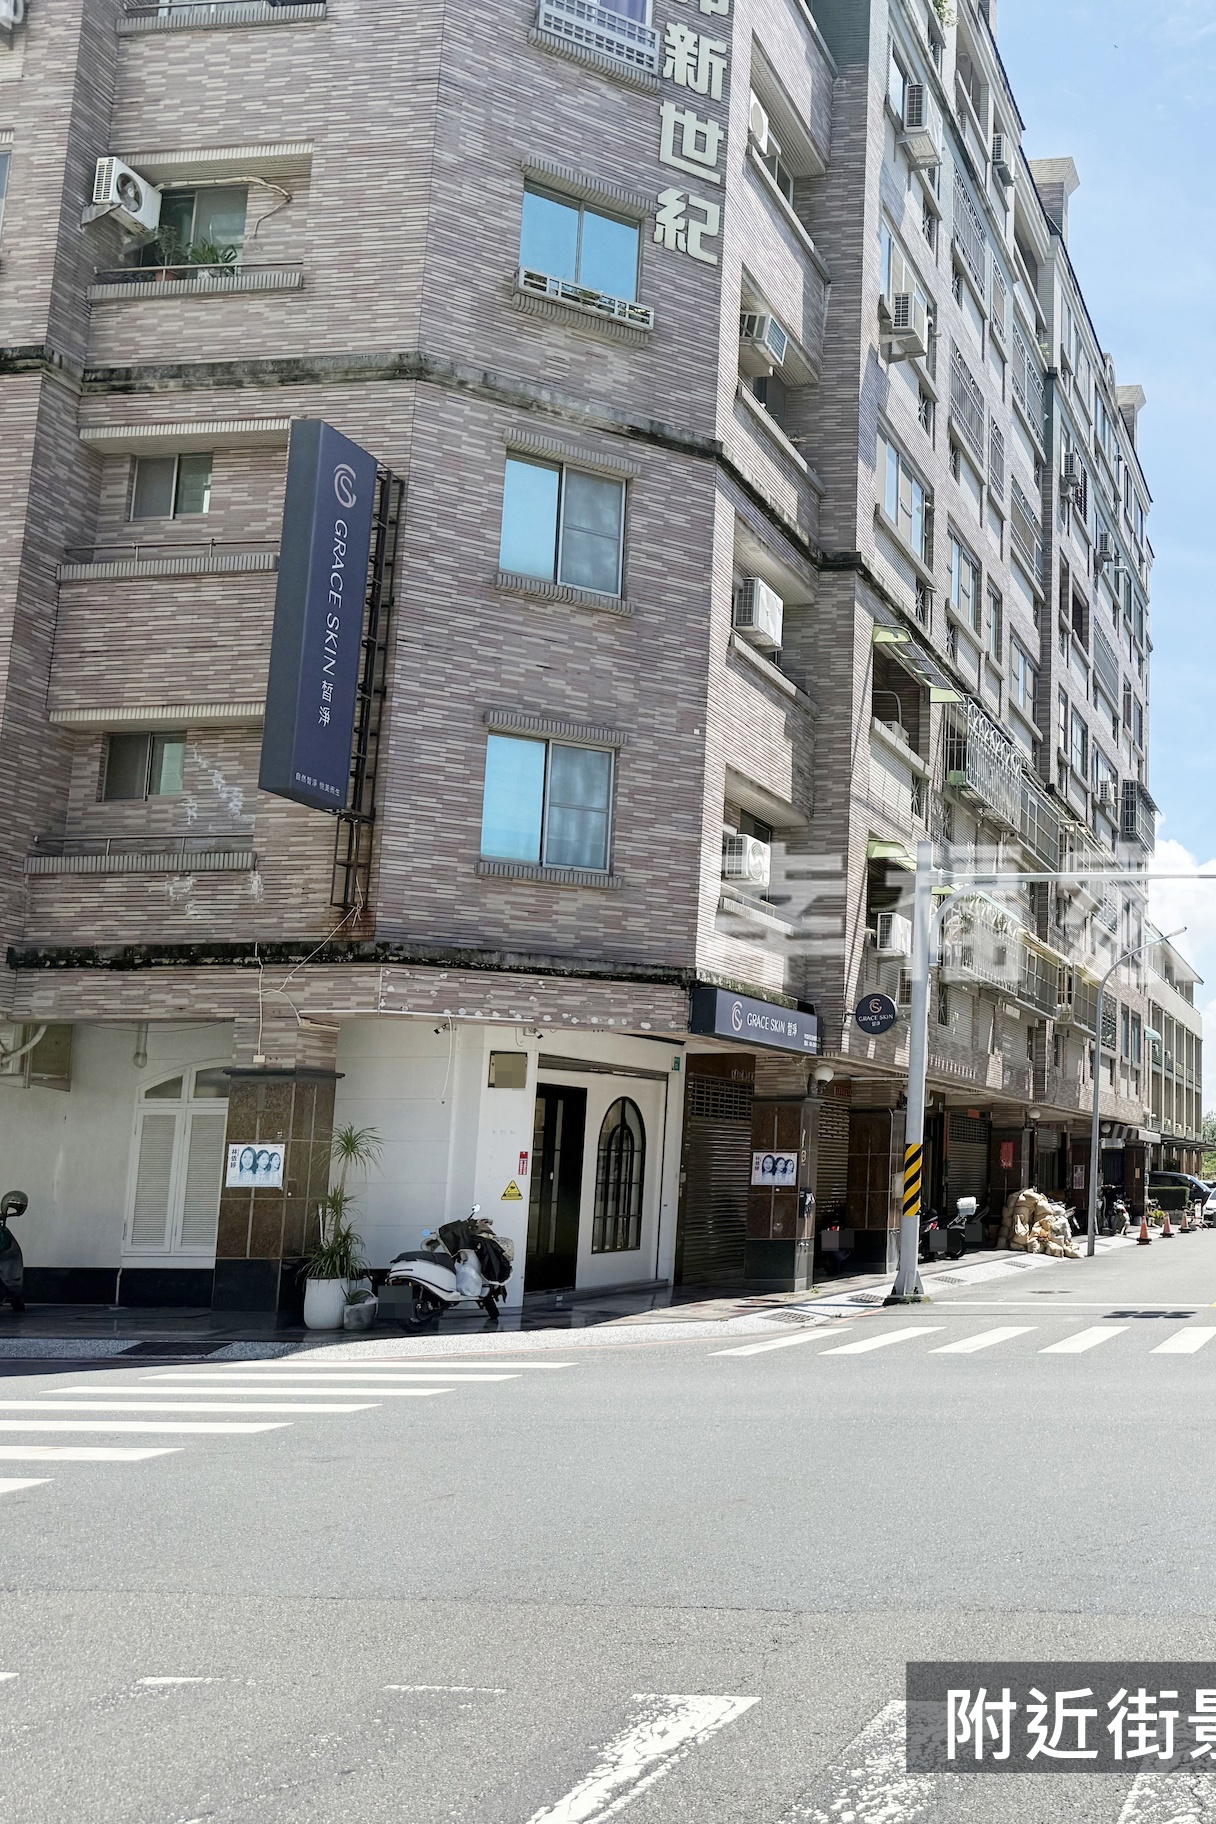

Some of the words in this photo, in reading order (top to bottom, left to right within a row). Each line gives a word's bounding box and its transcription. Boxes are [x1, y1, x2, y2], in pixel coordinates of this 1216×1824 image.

[653, 0, 729, 266] 新世紀
[328, 519, 348, 608] GRACE
[323, 613, 341, 676] SKIN
[747, 1012, 770, 1030] GRACE
[770, 1018, 786, 1034] SKIN
[858, 1014, 878, 1022] GRACE
